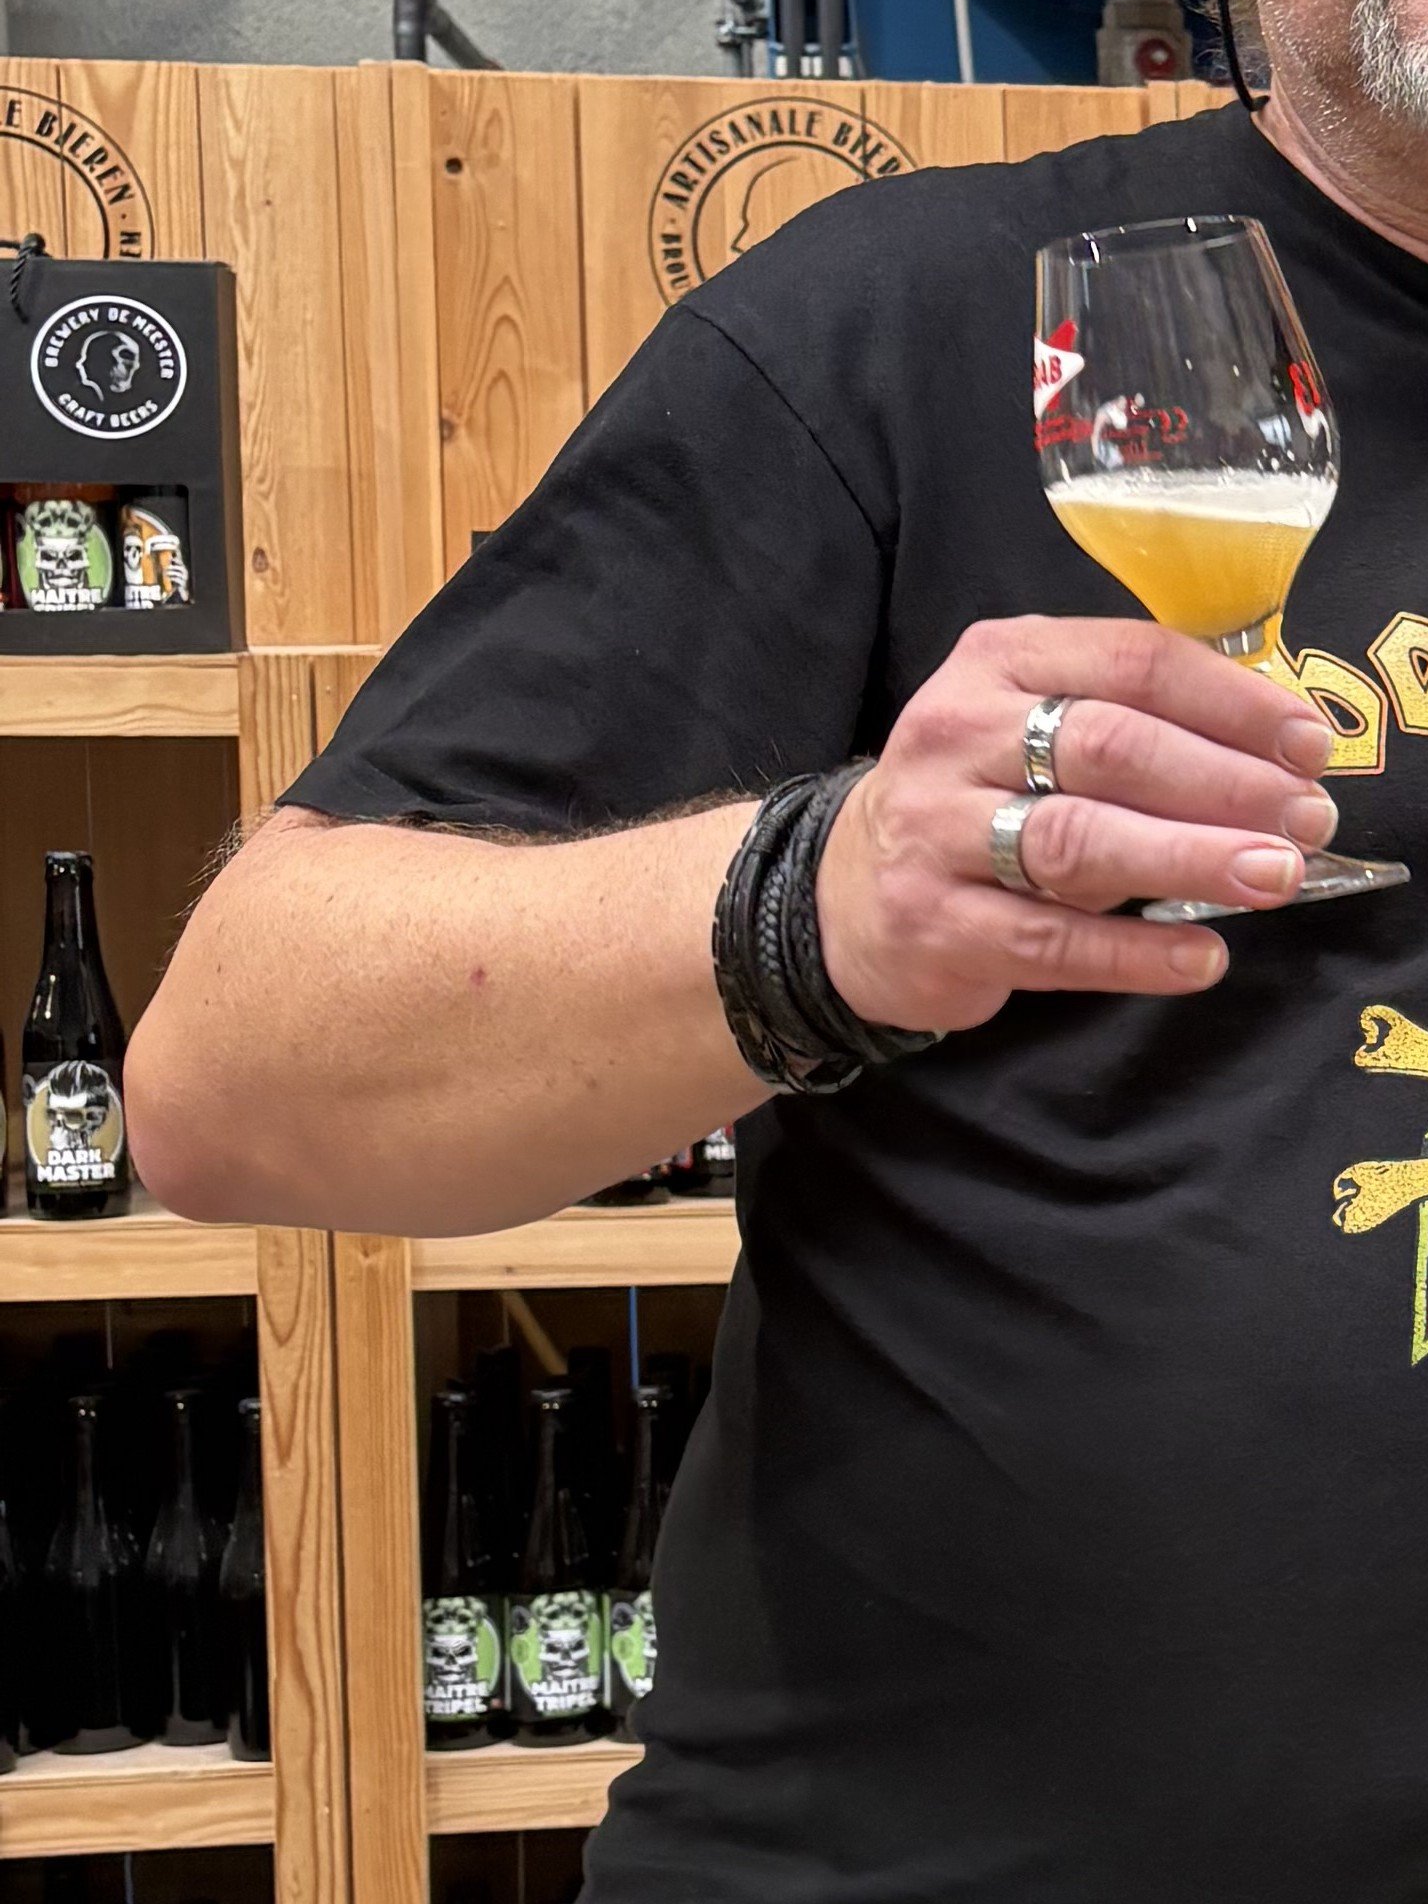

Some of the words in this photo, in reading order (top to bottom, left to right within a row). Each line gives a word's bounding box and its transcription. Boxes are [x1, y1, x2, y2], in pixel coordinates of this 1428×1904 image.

[36, 110, 135, 206] BIEREN
[662, 108, 823, 211] ARTISANALE
[45, 307, 99, 368] BREWERY
[107, 307, 131, 324] DE
[132, 317, 175, 380] MEESTER
[58, 393, 105, 427] CRAFT
[110, 399, 158, 428] BEERS
[37, 1162, 115, 1182] MASTER
[47, 1149, 101, 1165] DARK
